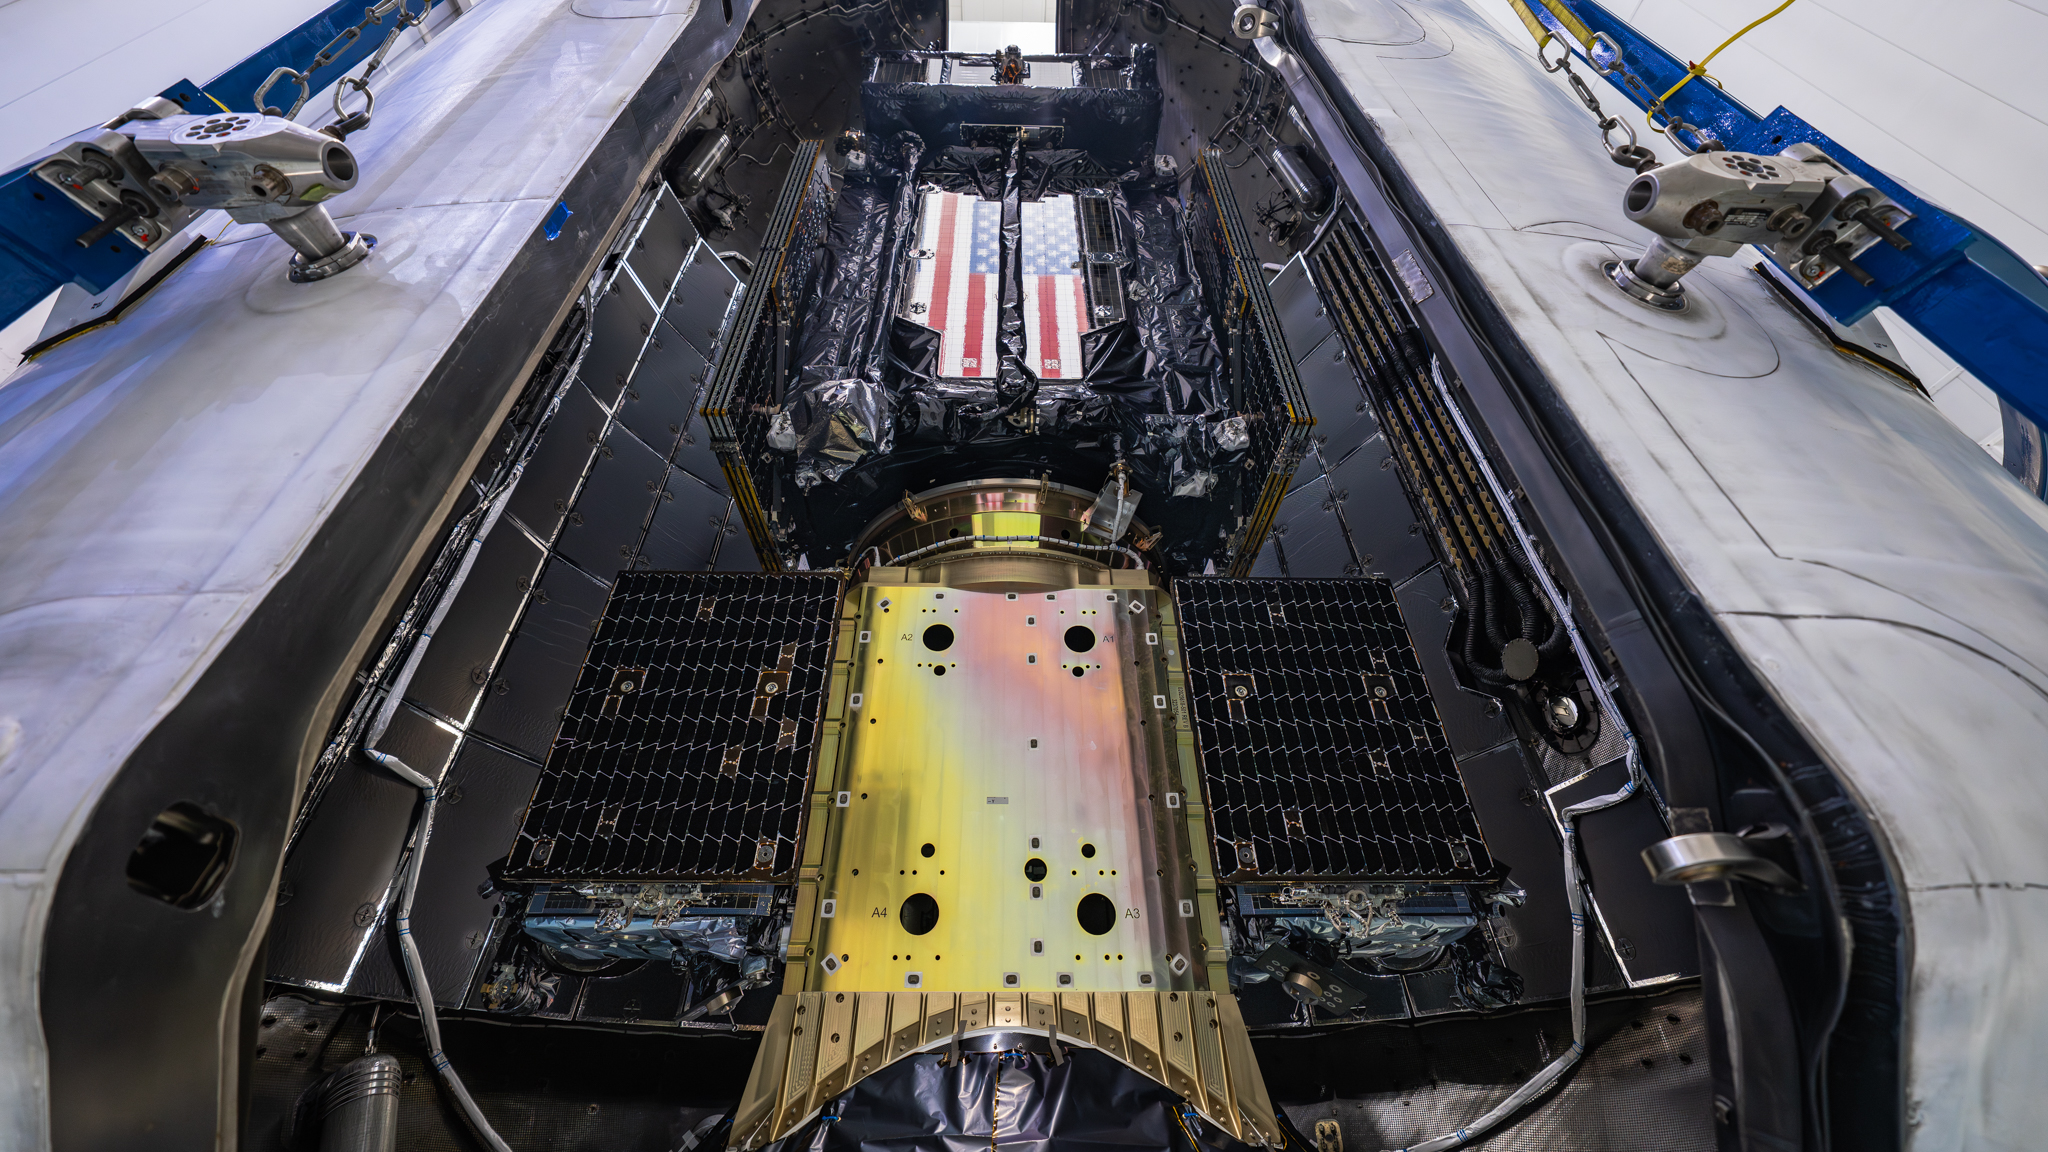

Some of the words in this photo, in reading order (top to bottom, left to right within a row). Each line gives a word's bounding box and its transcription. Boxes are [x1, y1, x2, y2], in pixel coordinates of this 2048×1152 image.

[900, 633, 913, 641] A2
[1102, 635, 1114, 643] A1
[871, 906, 888, 918] A4
[1125, 907, 1140, 919] A3
